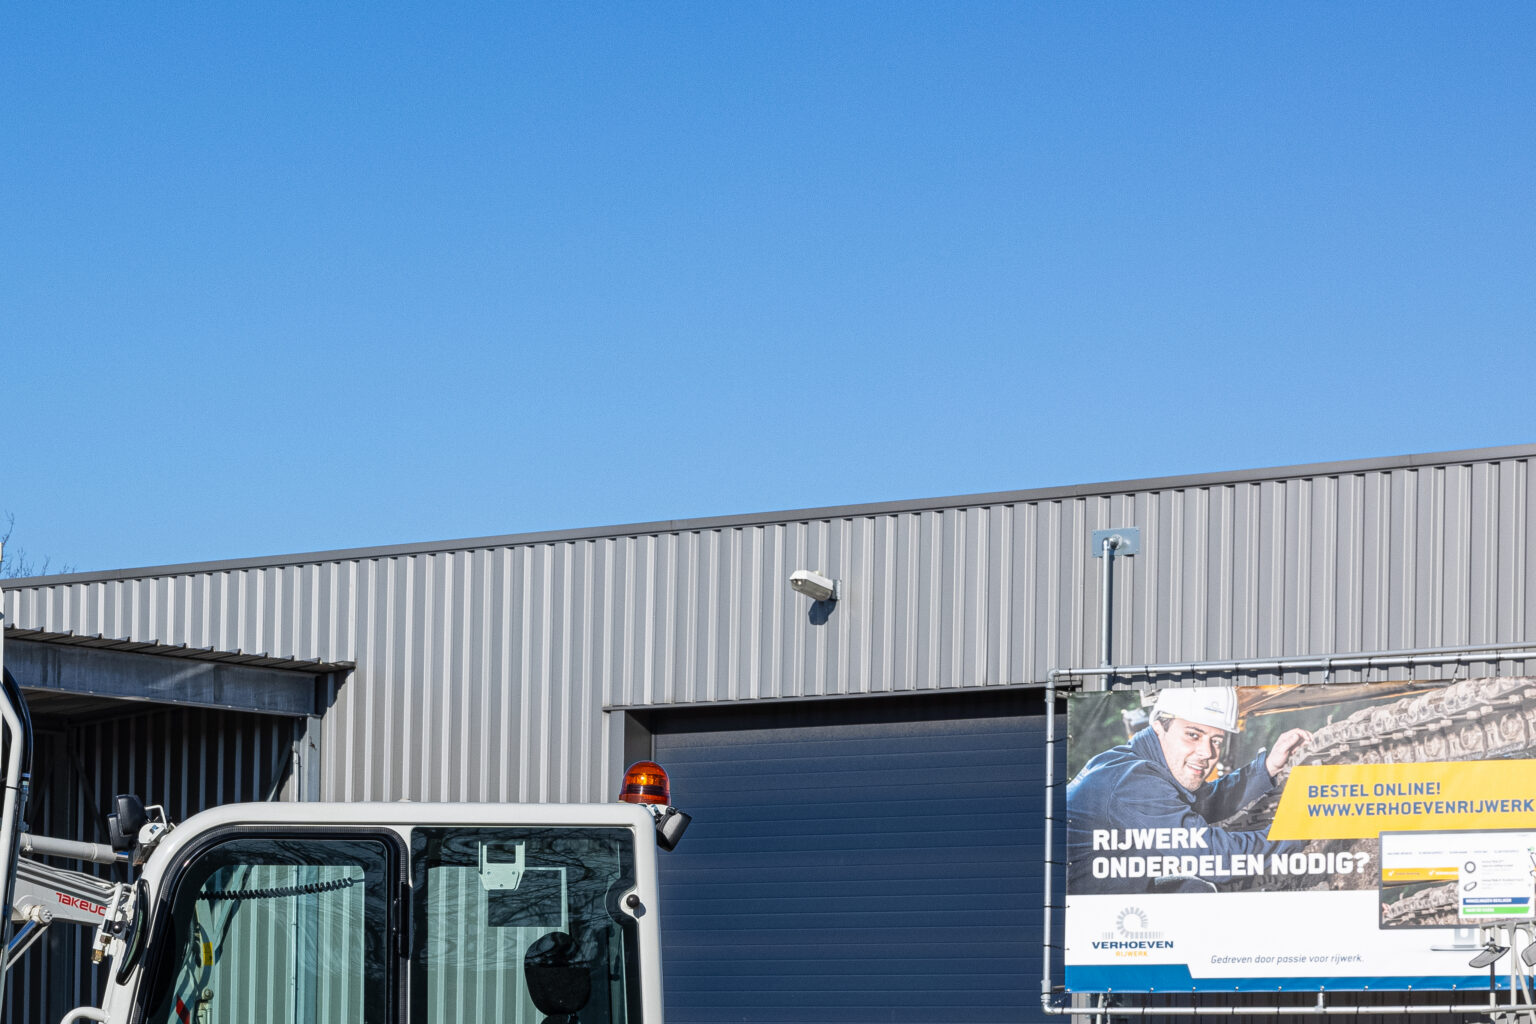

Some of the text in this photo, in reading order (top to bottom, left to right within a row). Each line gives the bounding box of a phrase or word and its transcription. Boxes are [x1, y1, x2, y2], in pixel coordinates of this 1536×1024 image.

[1308, 782, 1441, 798] BESTEL ONLINE!
[1092, 827, 1209, 851] RIJWERK
[1091, 850, 1371, 879] ONDERDELEN NODIG?
[55, 891, 107, 917] TAKEUC
[1092, 940, 1174, 950] VERHOEVEN
[1210, 955, 1253, 964] Gedreven
[1254, 955, 1275, 964] door
[1276, 954, 1307, 965] passie
[1309, 954, 1329, 963] voor
